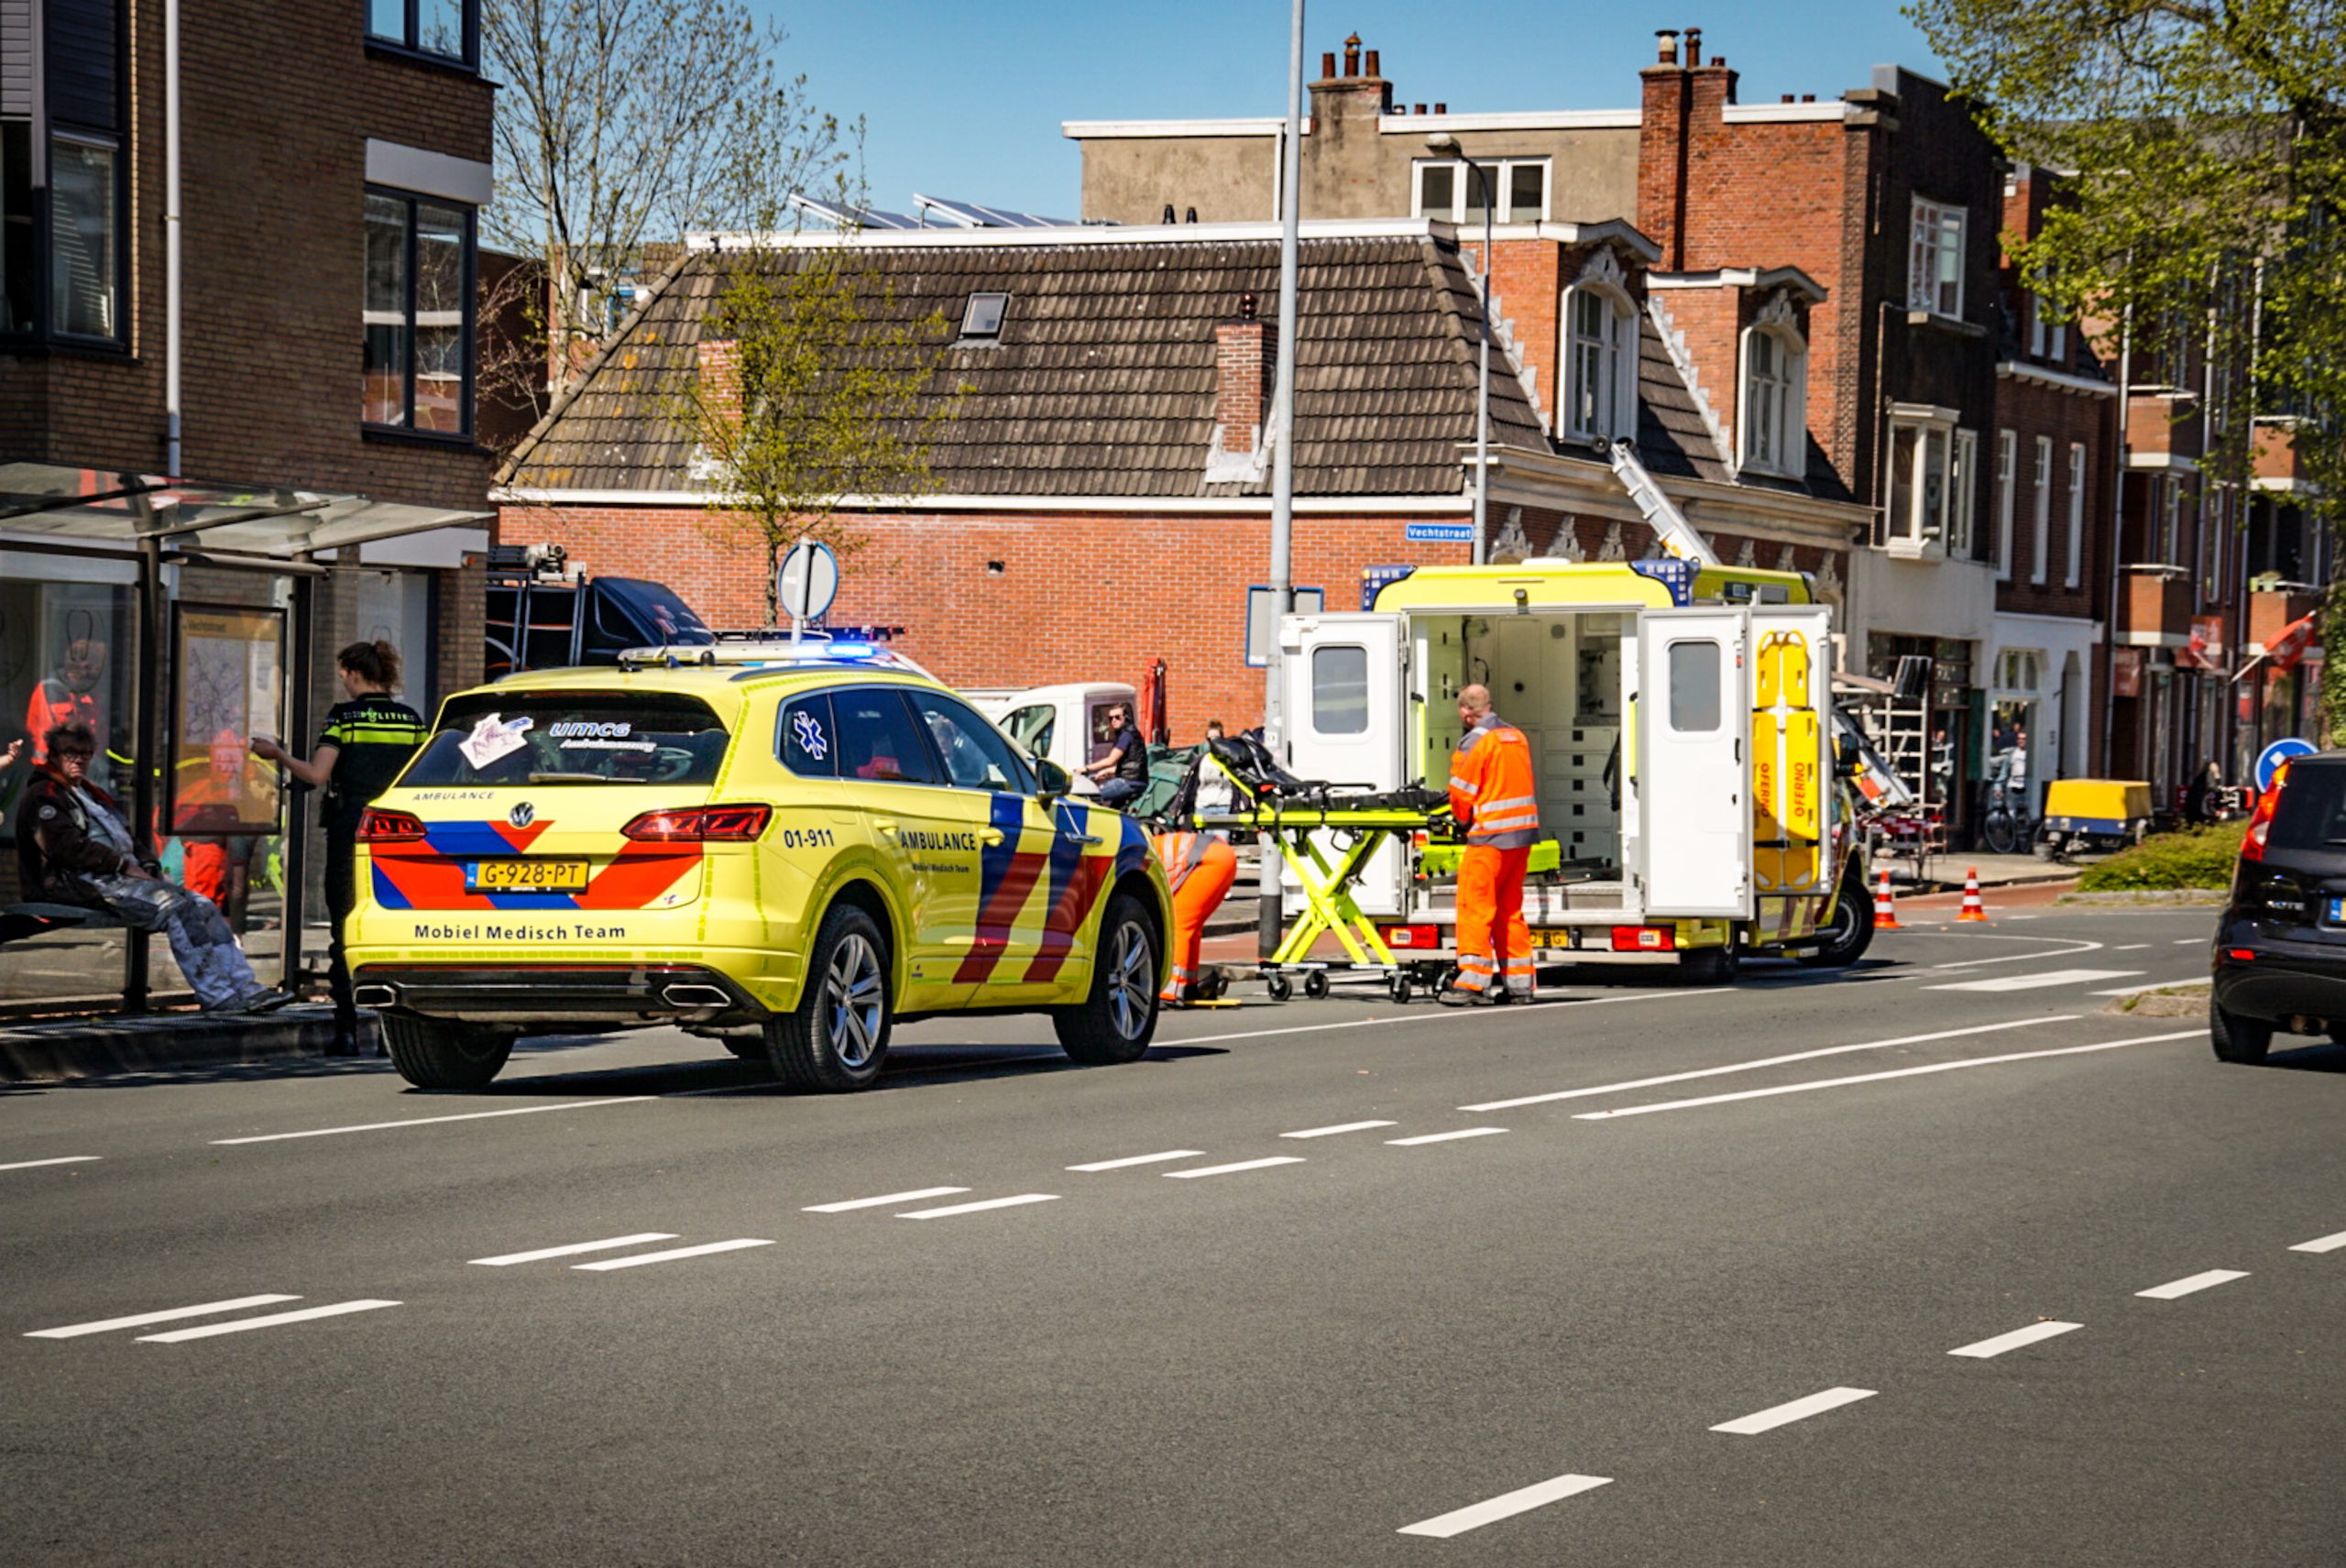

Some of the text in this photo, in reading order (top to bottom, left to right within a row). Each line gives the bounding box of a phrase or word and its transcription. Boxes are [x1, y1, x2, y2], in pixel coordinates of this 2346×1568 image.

[1409, 527, 1472, 539] Vechtstraat
[412, 792, 495, 801] AMBULANCE
[784, 828, 835, 849] 01-911
[900, 831, 977, 851] AMBULANCE
[485, 863, 579, 883] G-928-PT
[414, 925, 626, 940] Mobiel Medisch Team
